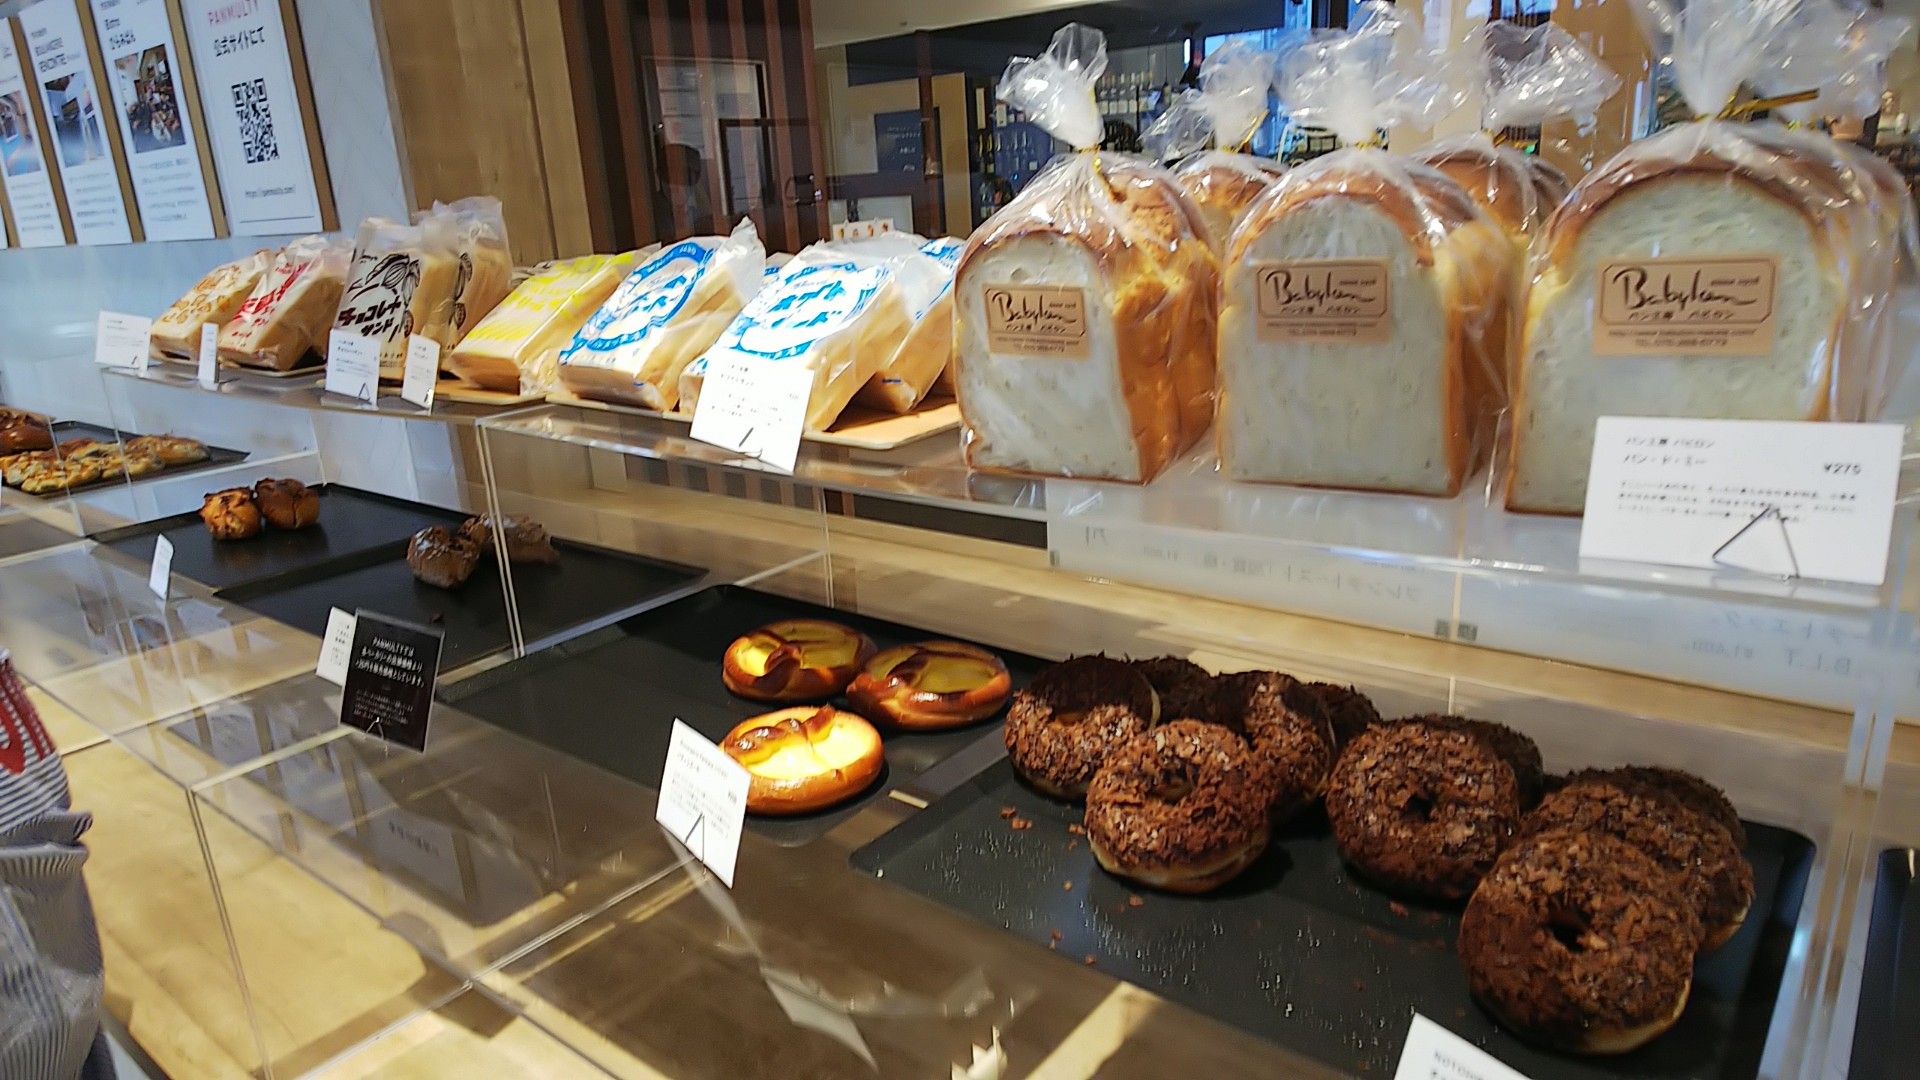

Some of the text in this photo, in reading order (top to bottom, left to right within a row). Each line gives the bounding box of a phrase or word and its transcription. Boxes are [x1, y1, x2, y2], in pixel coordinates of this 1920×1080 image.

[1264, 268, 1376, 306] Babylon
[1612, 267, 1757, 310] Babylon
[991, 292, 1077, 322] Babylon
